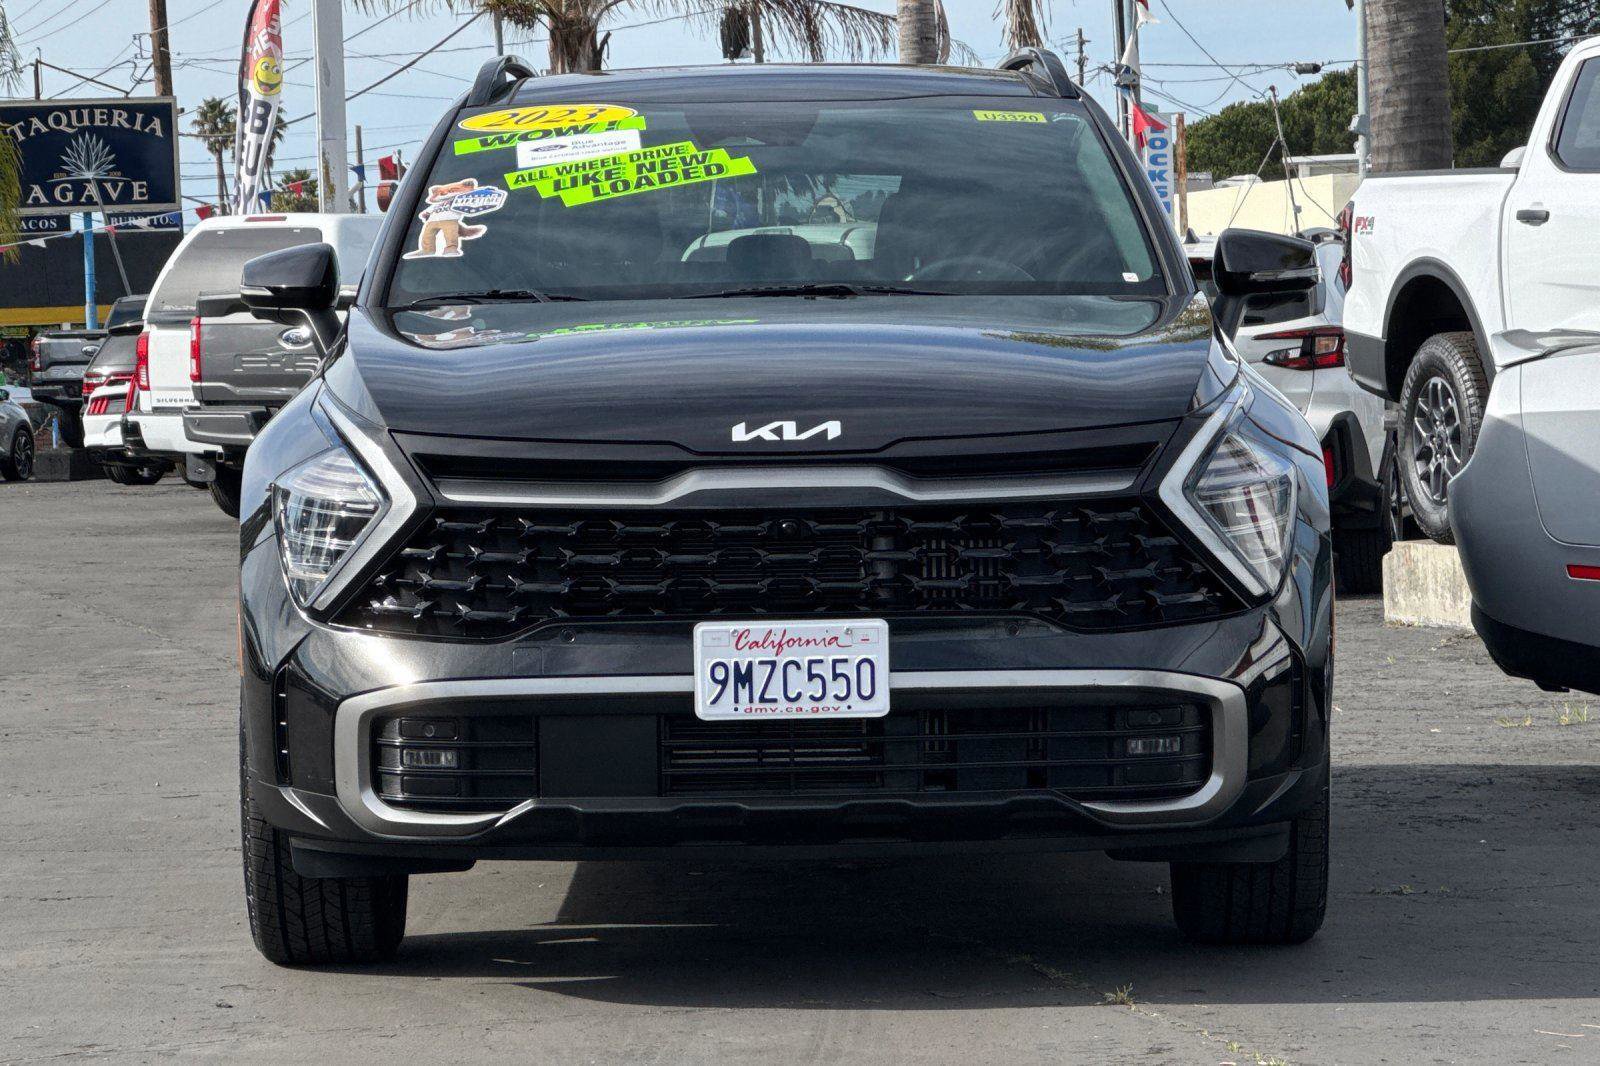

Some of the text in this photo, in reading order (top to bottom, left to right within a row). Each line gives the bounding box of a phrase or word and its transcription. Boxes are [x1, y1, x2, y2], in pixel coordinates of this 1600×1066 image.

[6, 108, 164, 143] TAQUERIA
[481, 108, 607, 127] 2023
[571, 140, 627, 150] Advantage
[513, 145, 688, 185] ALL WHEEL DRIVE
[553, 152, 710, 192] LIKE NEW
[592, 163, 726, 197] LOADED
[26, 180, 149, 204] AGAVE
[20, 218, 58, 230] ACOS
[1355, 216, 1375, 233] FX4
[234, 353, 320, 373] F-15
[731, 421, 842, 442] KIA
[735, 628, 852, 657] California
[709, 658, 876, 705] 9MZC550
[744, 705, 841, 714] dmv.ca.gov
